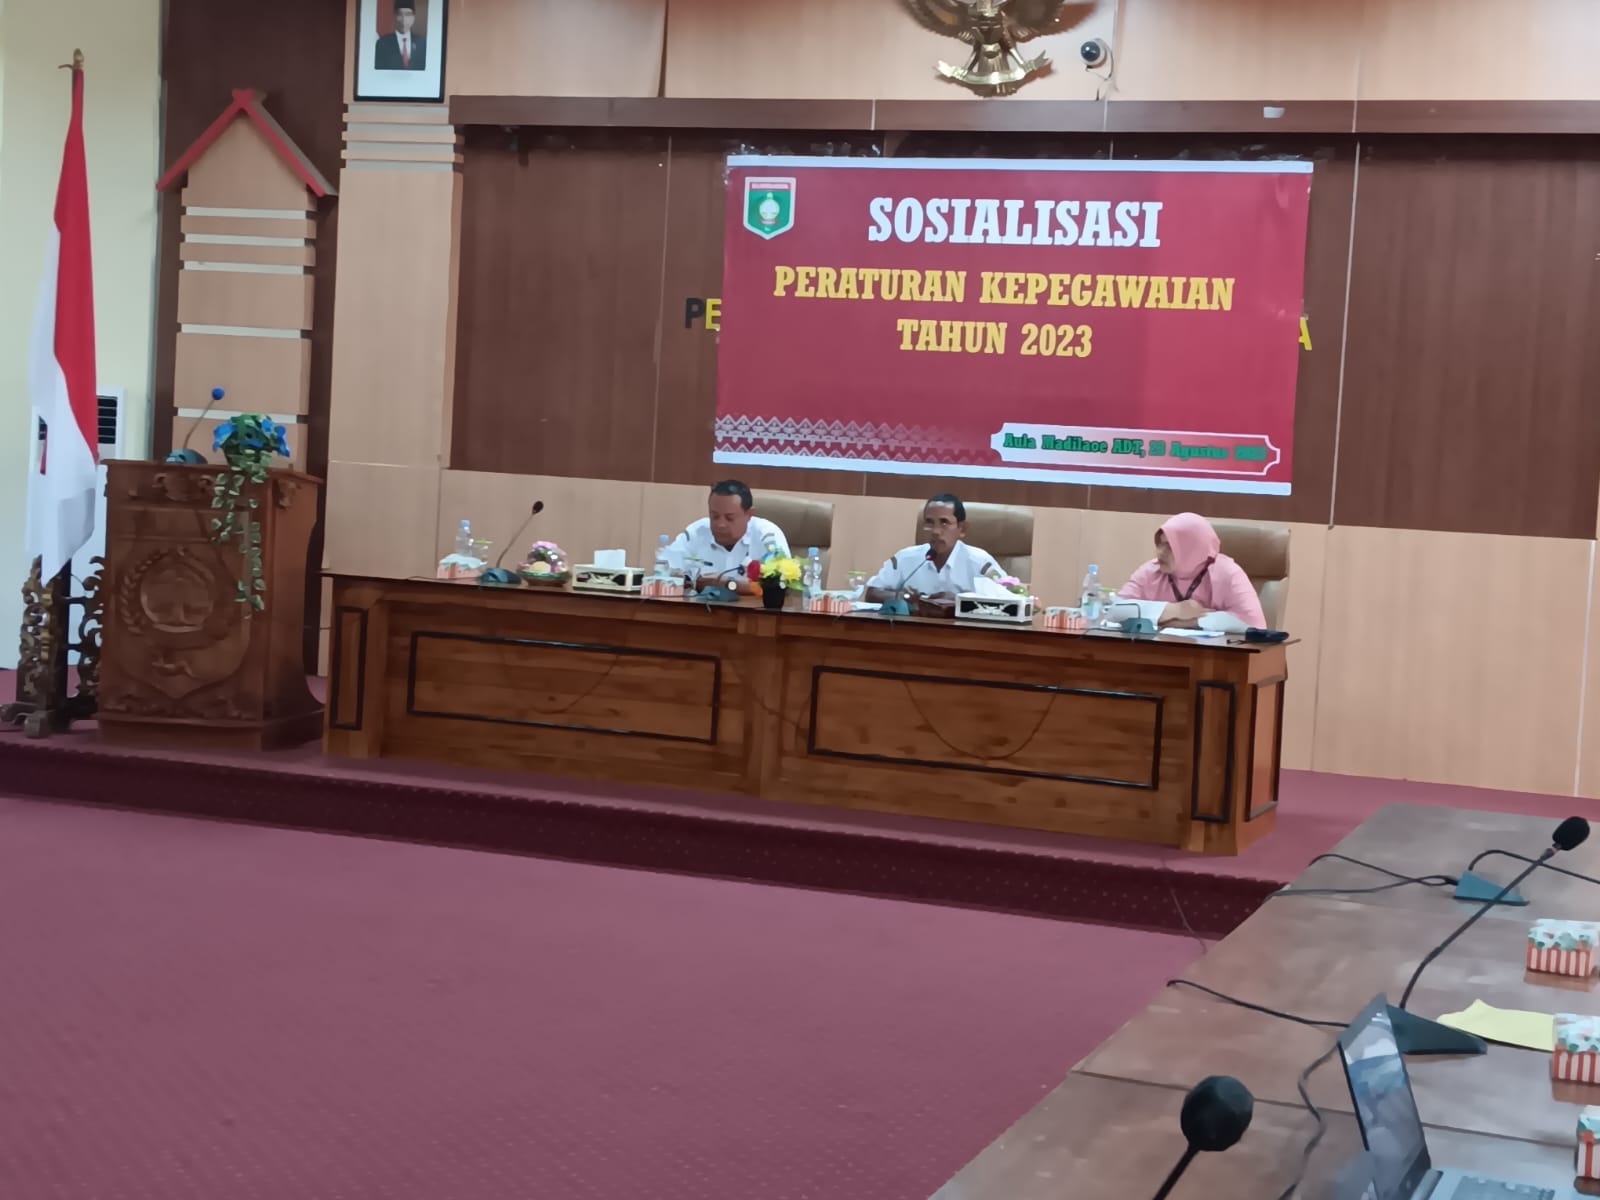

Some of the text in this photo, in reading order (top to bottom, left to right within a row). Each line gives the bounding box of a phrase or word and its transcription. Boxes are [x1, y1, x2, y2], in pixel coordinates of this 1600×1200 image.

[868, 196, 1164, 248] SOSIALISASI
[773, 265, 1236, 311] PERATURAN KEPEGAWAIAN
[897, 318, 1093, 358] TAHUN 2023
[1003, 433, 1037, 449] Aula
